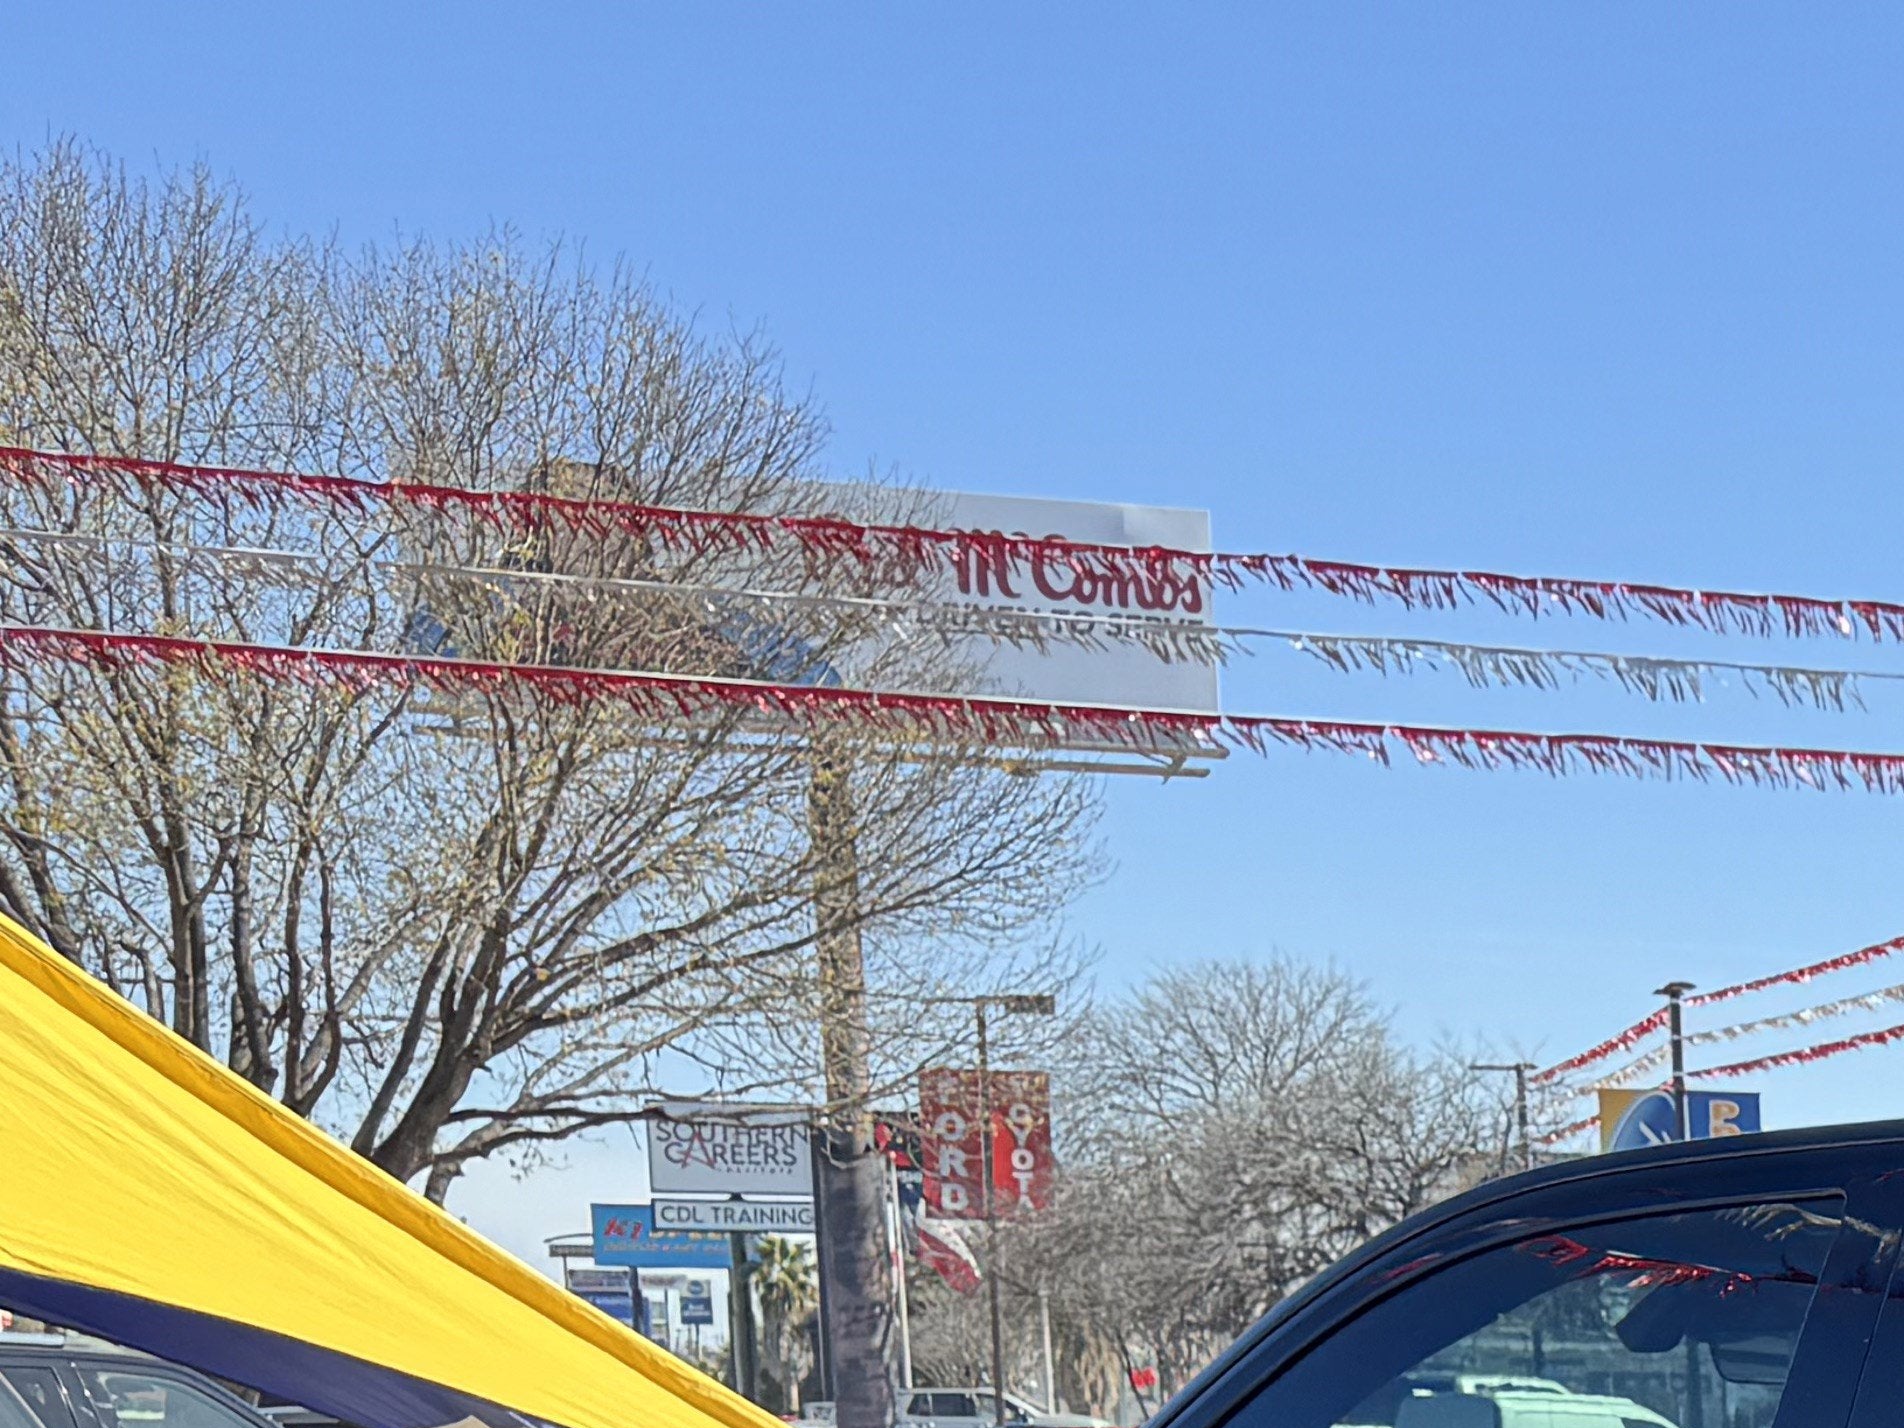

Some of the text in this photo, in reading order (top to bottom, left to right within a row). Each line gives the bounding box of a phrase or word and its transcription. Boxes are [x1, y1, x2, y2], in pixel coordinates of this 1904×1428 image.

[656, 1121, 809, 1149] SOUTHERN
[664, 1132, 798, 1169] CAREERS
[661, 1206, 814, 1225] CDL TRAINING
